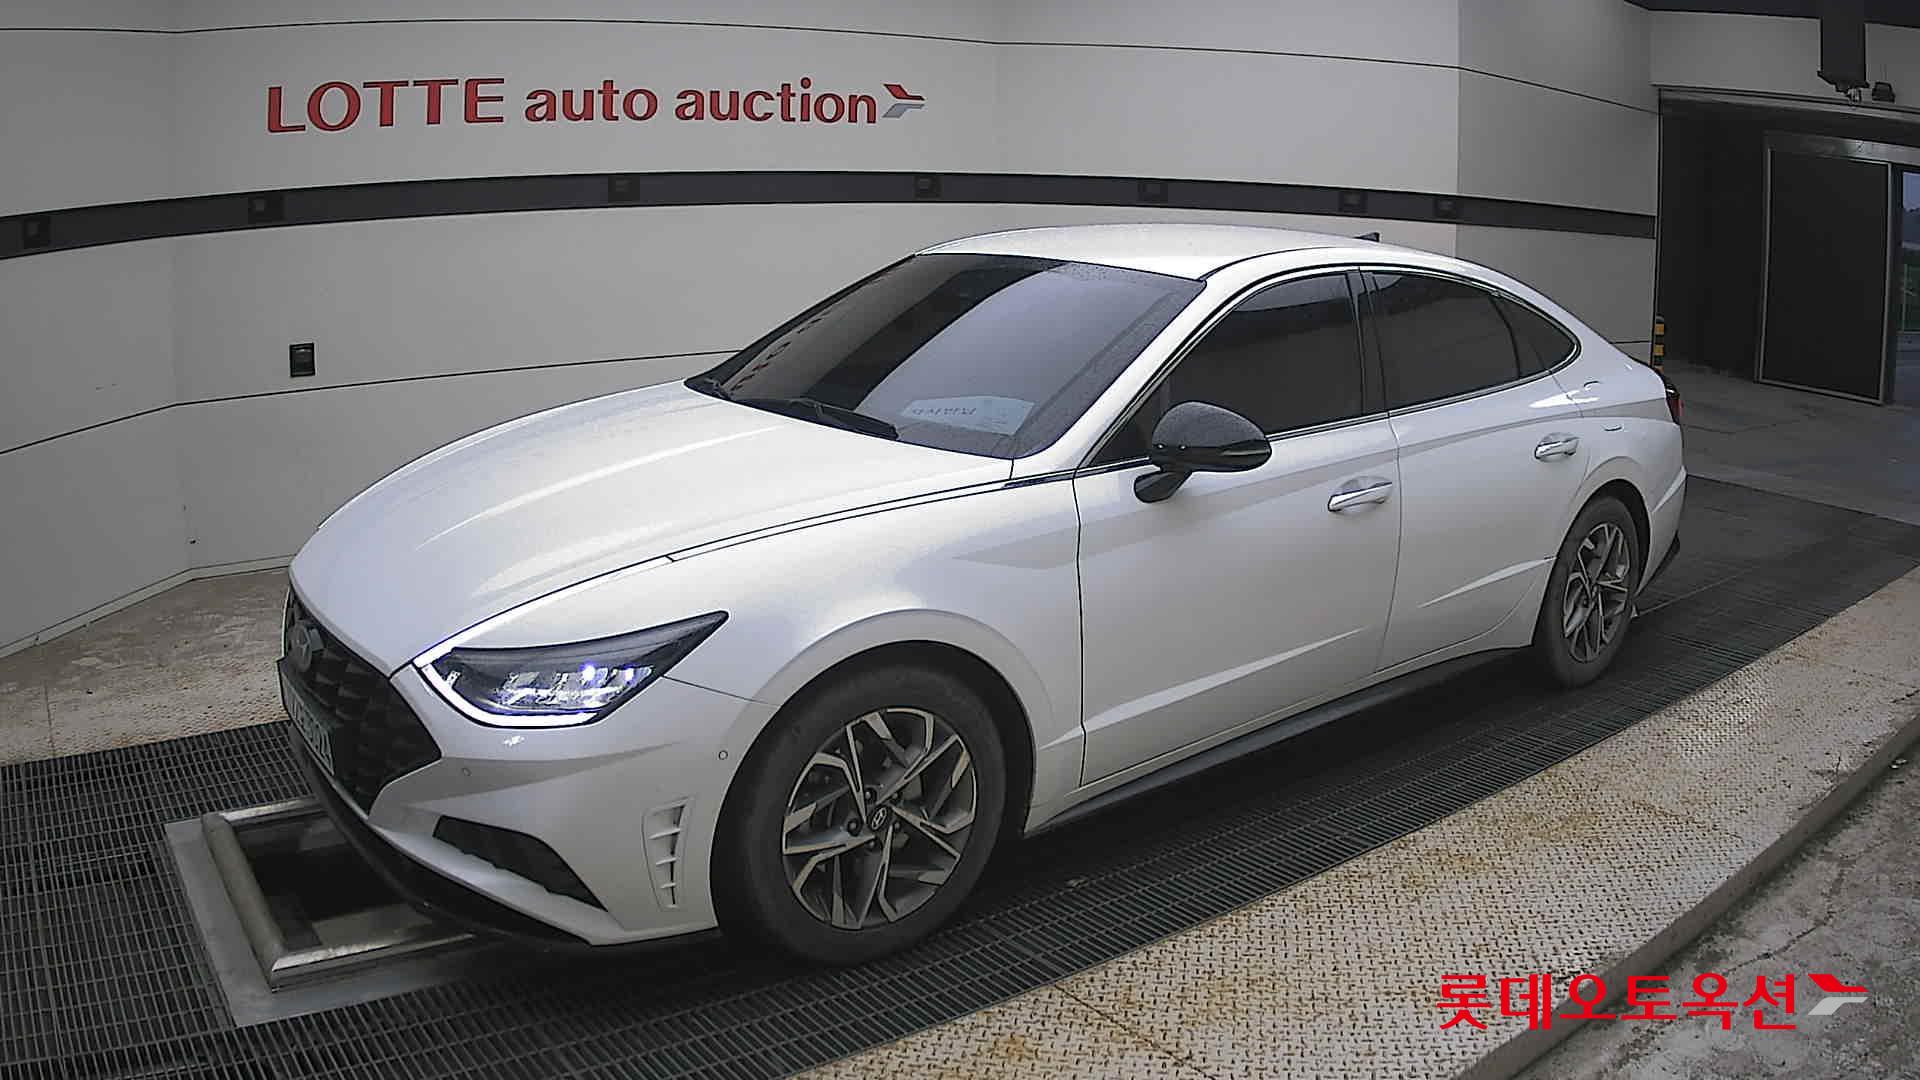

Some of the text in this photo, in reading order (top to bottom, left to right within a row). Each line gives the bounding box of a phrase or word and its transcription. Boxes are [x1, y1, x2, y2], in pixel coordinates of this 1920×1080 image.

[267, 77, 877, 133] LOTTE auto auction
